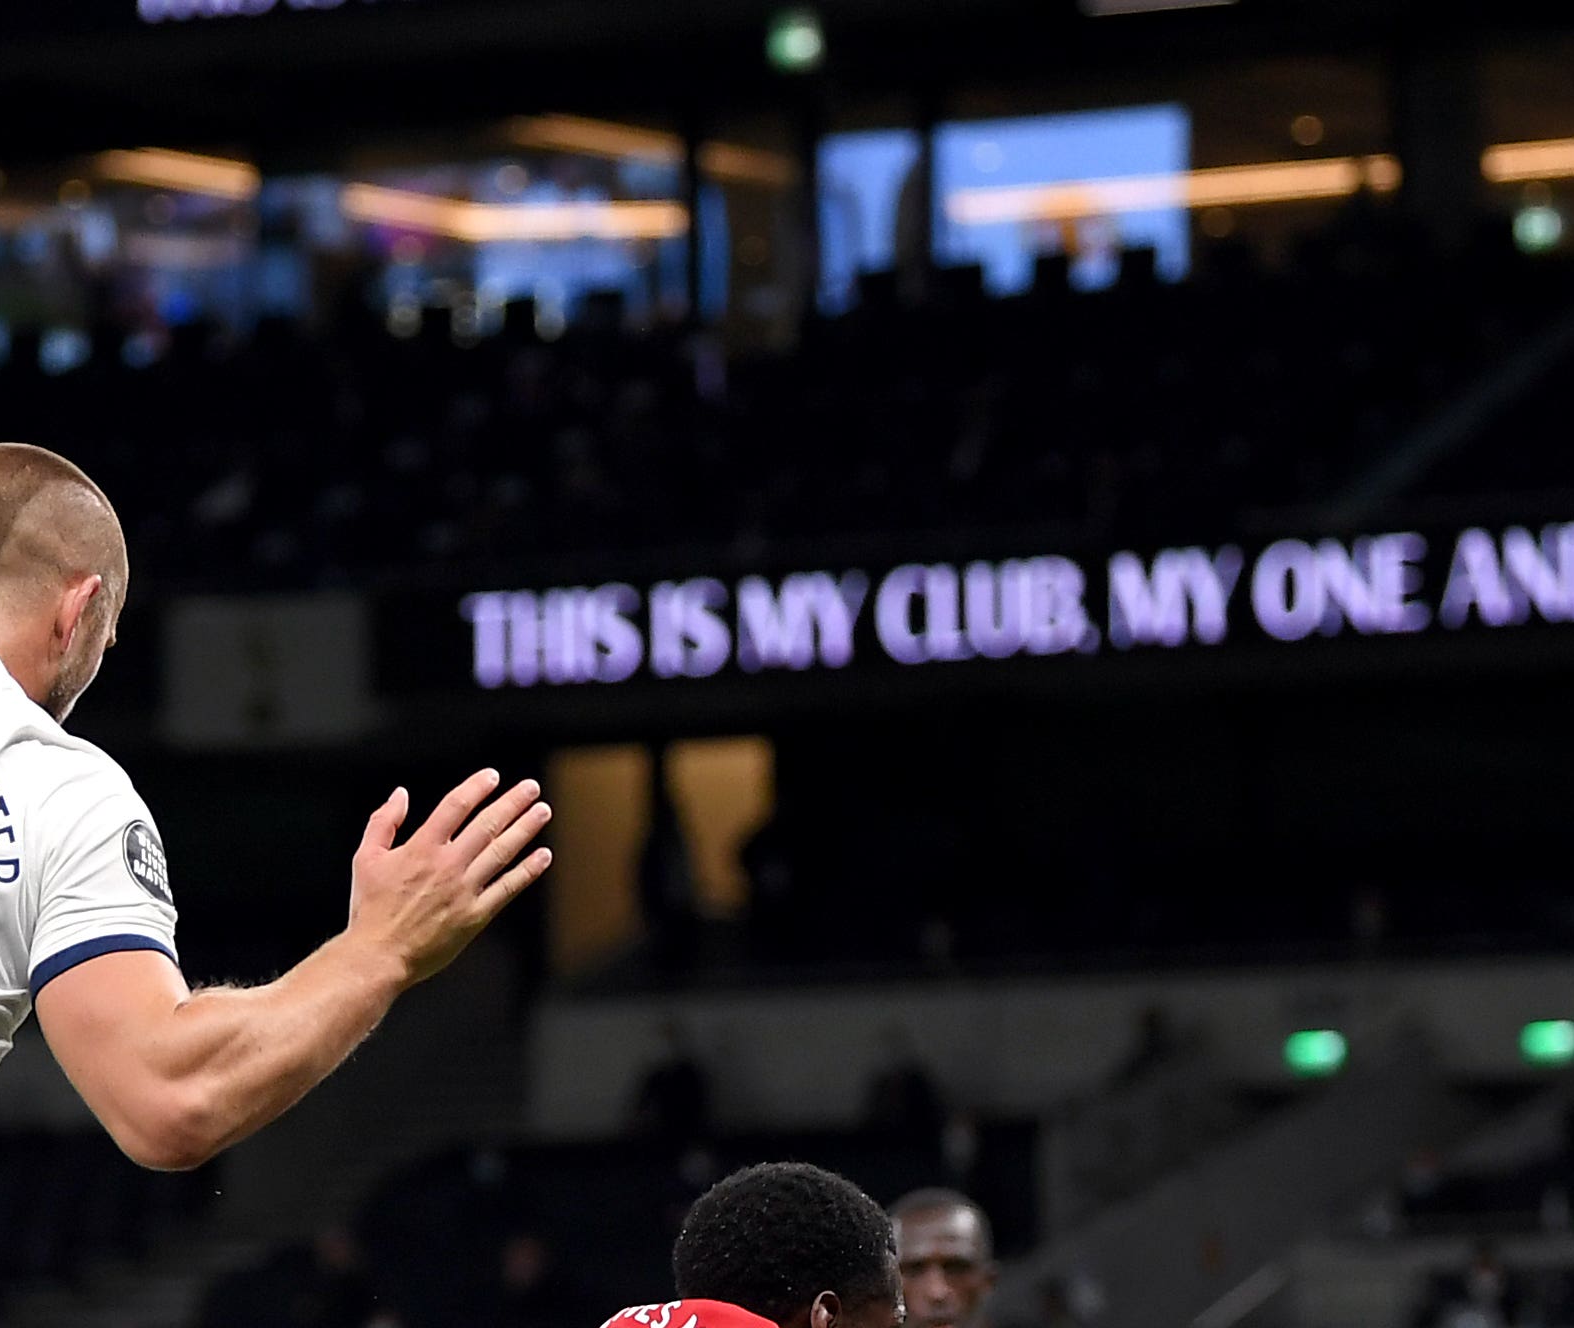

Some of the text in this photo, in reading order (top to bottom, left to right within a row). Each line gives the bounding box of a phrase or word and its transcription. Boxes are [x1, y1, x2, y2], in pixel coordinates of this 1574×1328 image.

[458, 582, 643, 689] THIS
[649, 577, 731, 678] IS
[736, 568, 868, 673] MY
[1106, 544, 1245, 650] MY
[1252, 531, 1432, 642] ONE
